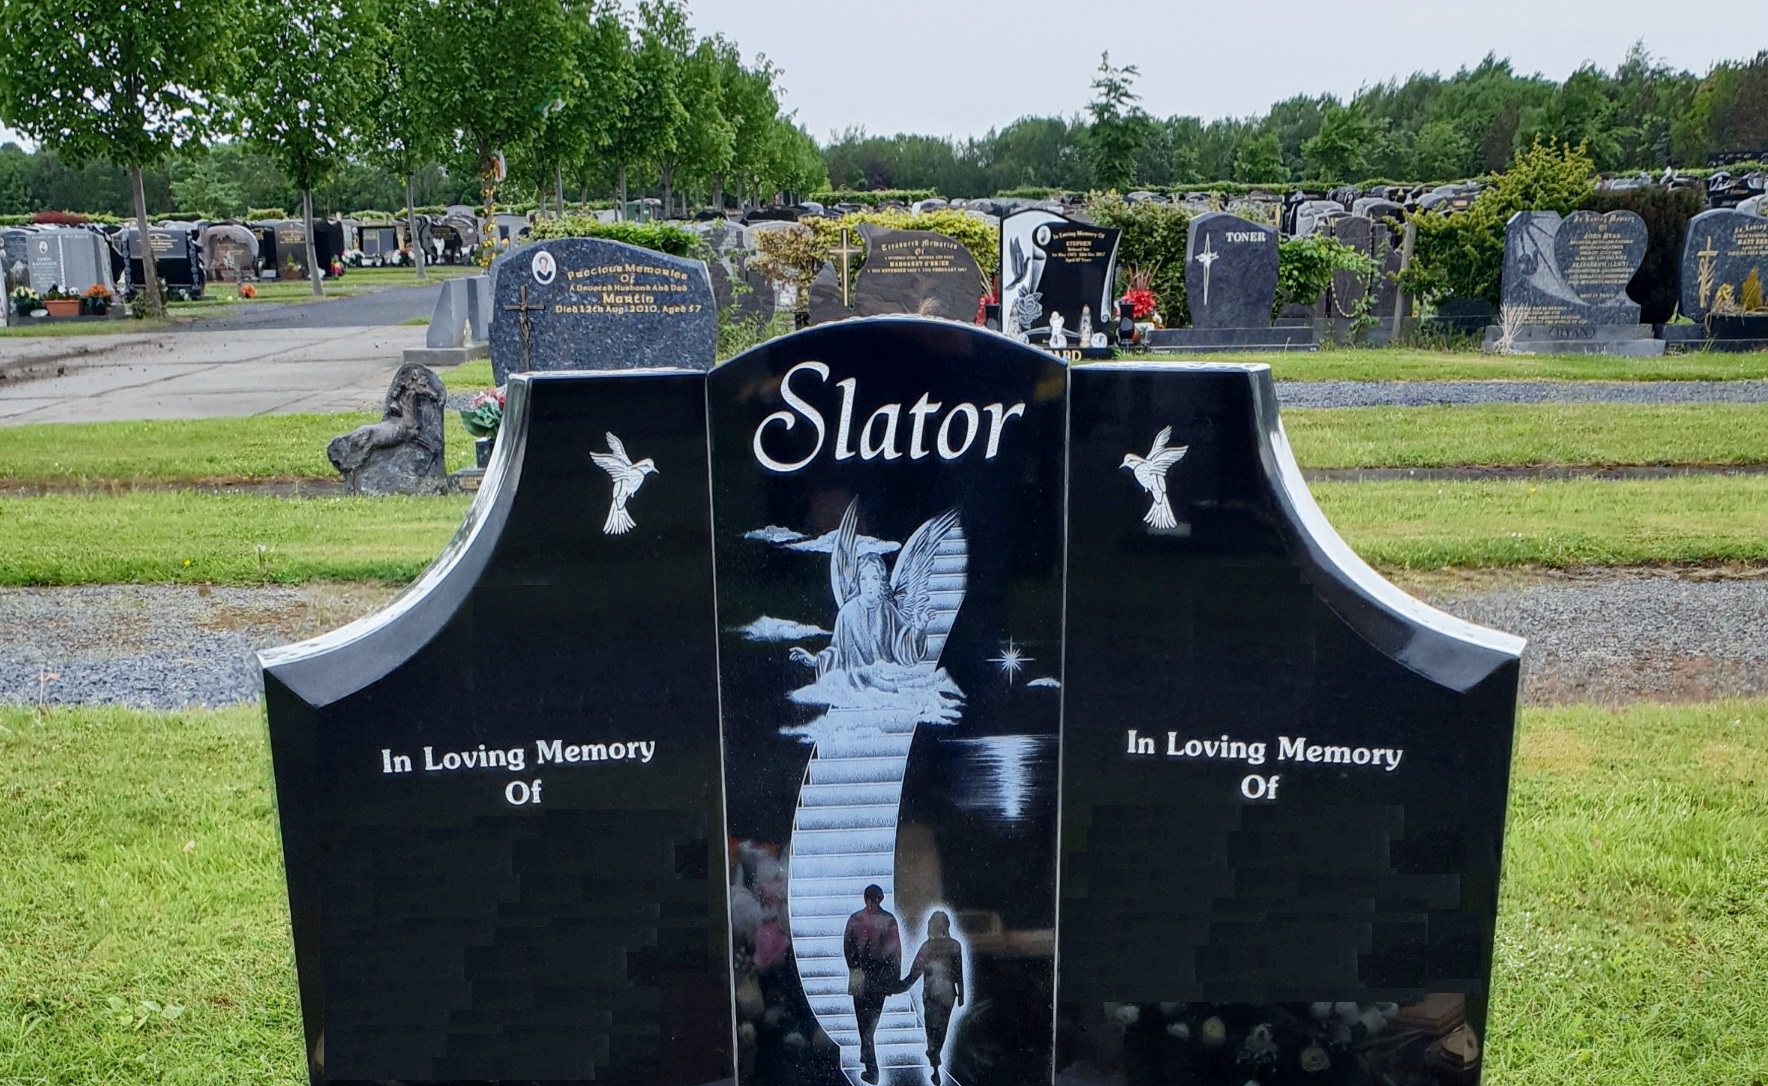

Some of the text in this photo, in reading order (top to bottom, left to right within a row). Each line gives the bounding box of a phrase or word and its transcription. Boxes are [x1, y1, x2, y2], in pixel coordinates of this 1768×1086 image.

[1226, 232, 1266, 242] TONER
[567, 264, 688, 280] Precious Memories
[620, 274, 635, 284] Of
[602, 292, 654, 304] Martin
[555, 305, 577, 313] Died
[579, 305, 604, 313] 12th
[662, 305, 686, 314] Aged
[753, 360, 1026, 472] Slator
[382, 740, 656, 773] In Loving Memory
[1127, 730, 1404, 771] In Loving Memory
[505, 779, 543, 806] Of
[1240, 774, 1280, 800] Of
